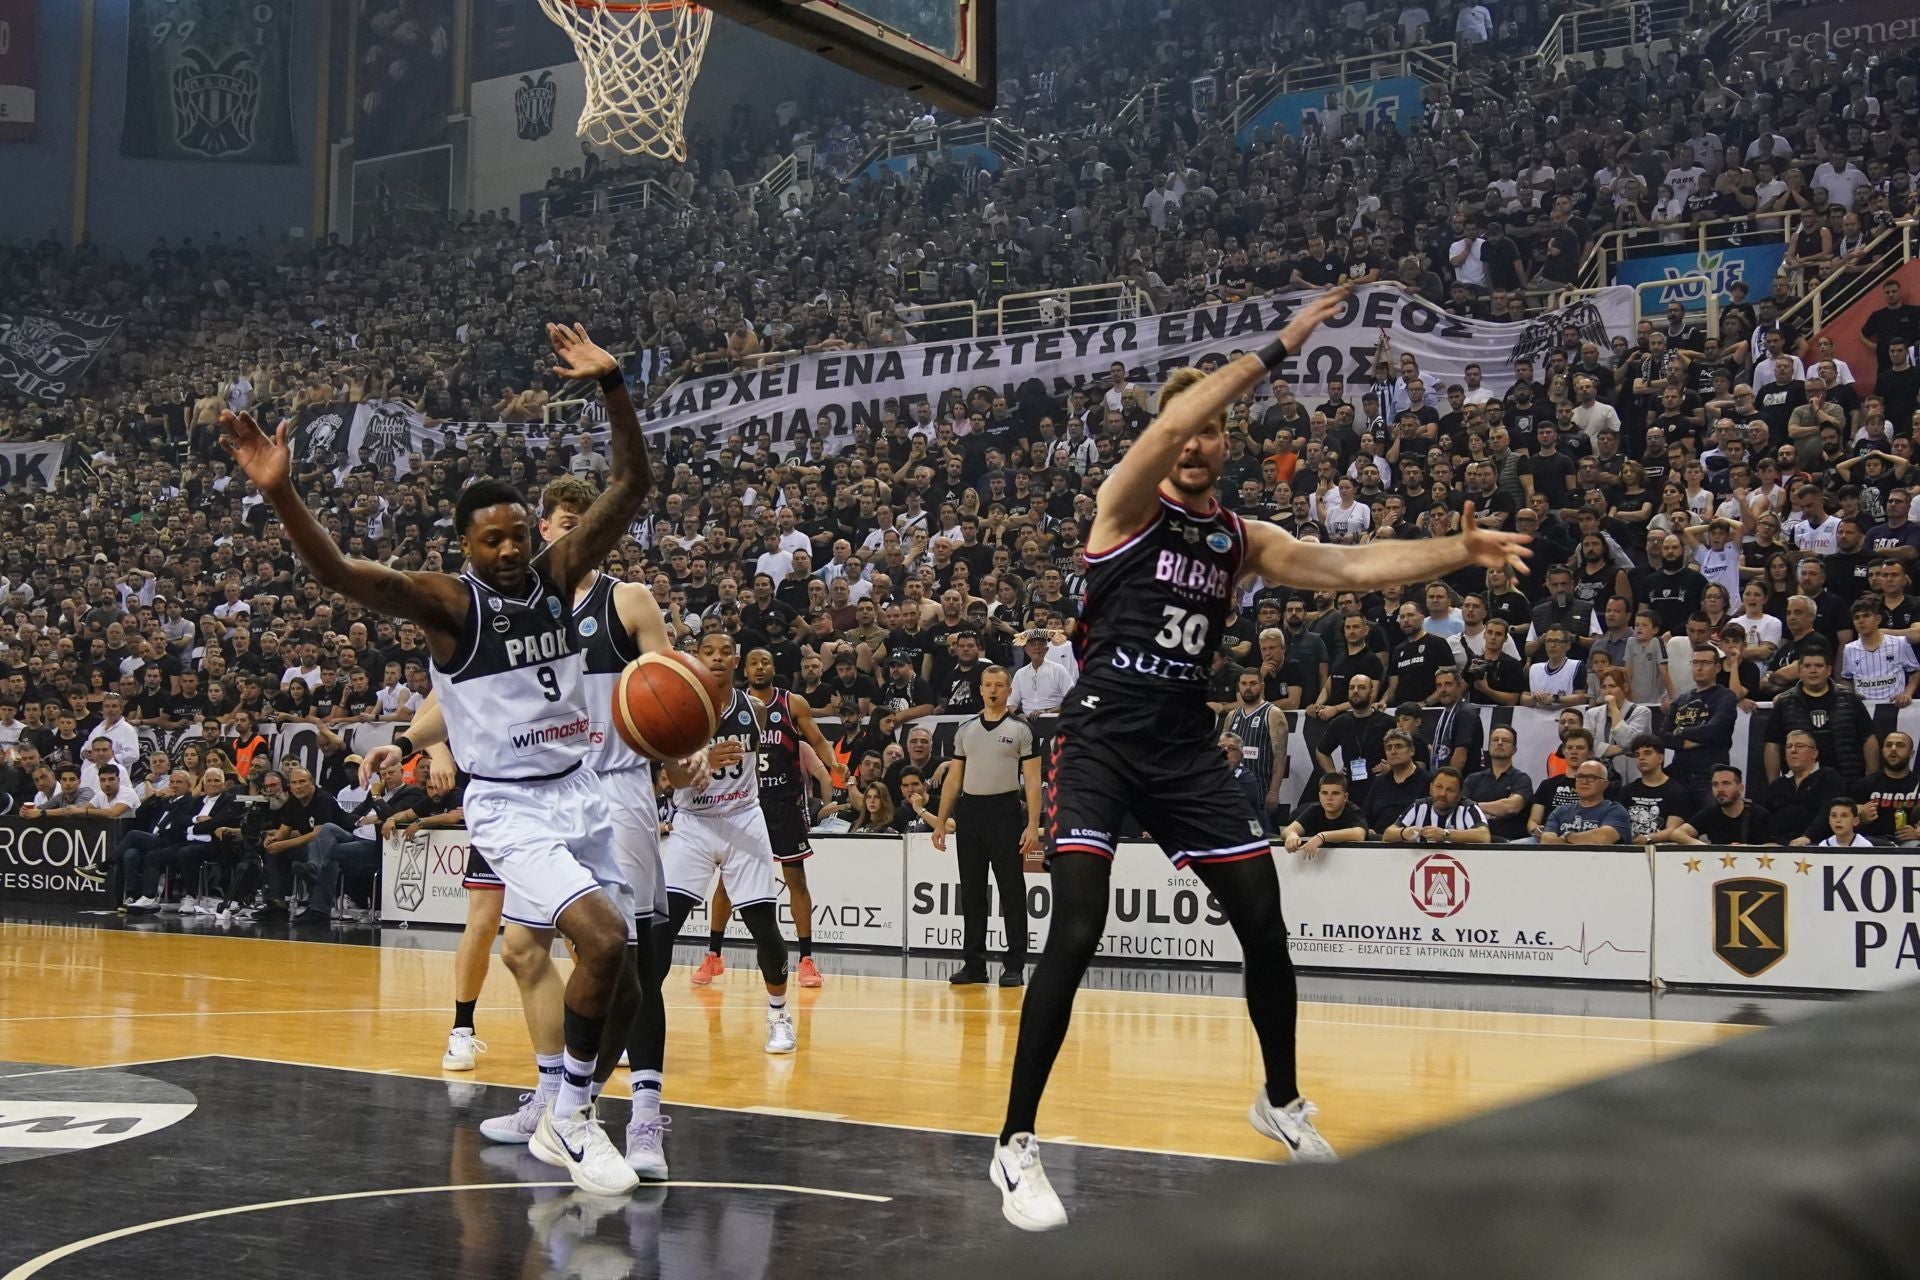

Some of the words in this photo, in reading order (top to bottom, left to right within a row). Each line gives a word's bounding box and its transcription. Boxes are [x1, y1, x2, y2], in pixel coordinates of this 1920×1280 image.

[815, 349, 906, 391] ΕΝΑ
[921, 320, 1139, 377] ΠΙΣΤΕΥΩ
[1157, 298, 1303, 348] ΕΝΑΣ
[1155, 549, 1229, 599] BILBAO
[504, 627, 571, 667] PAOK
[1154, 604, 1209, 656] 30
[536, 665, 562, 703] 9
[759, 753, 769, 772] 5
[1167, 875, 1199, 888] since
[1299, 923, 1314, 938] Γ.
[1322, 924, 1423, 941] ΠΑΠΟΥΔΗΣ
[1431, 926, 1446, 942] &
[1455, 928, 1500, 944] ΥΙΟΣ
[1357, 944, 1412, 956] ΕΙΣΑΓΩΓΕΣ
[1416, 947, 1465, 958] ΙΑΤΡΙΚΩΝ
[1468, 948, 1555, 961] ΜΗΧΑΝΗΜΑΤΩΝ
